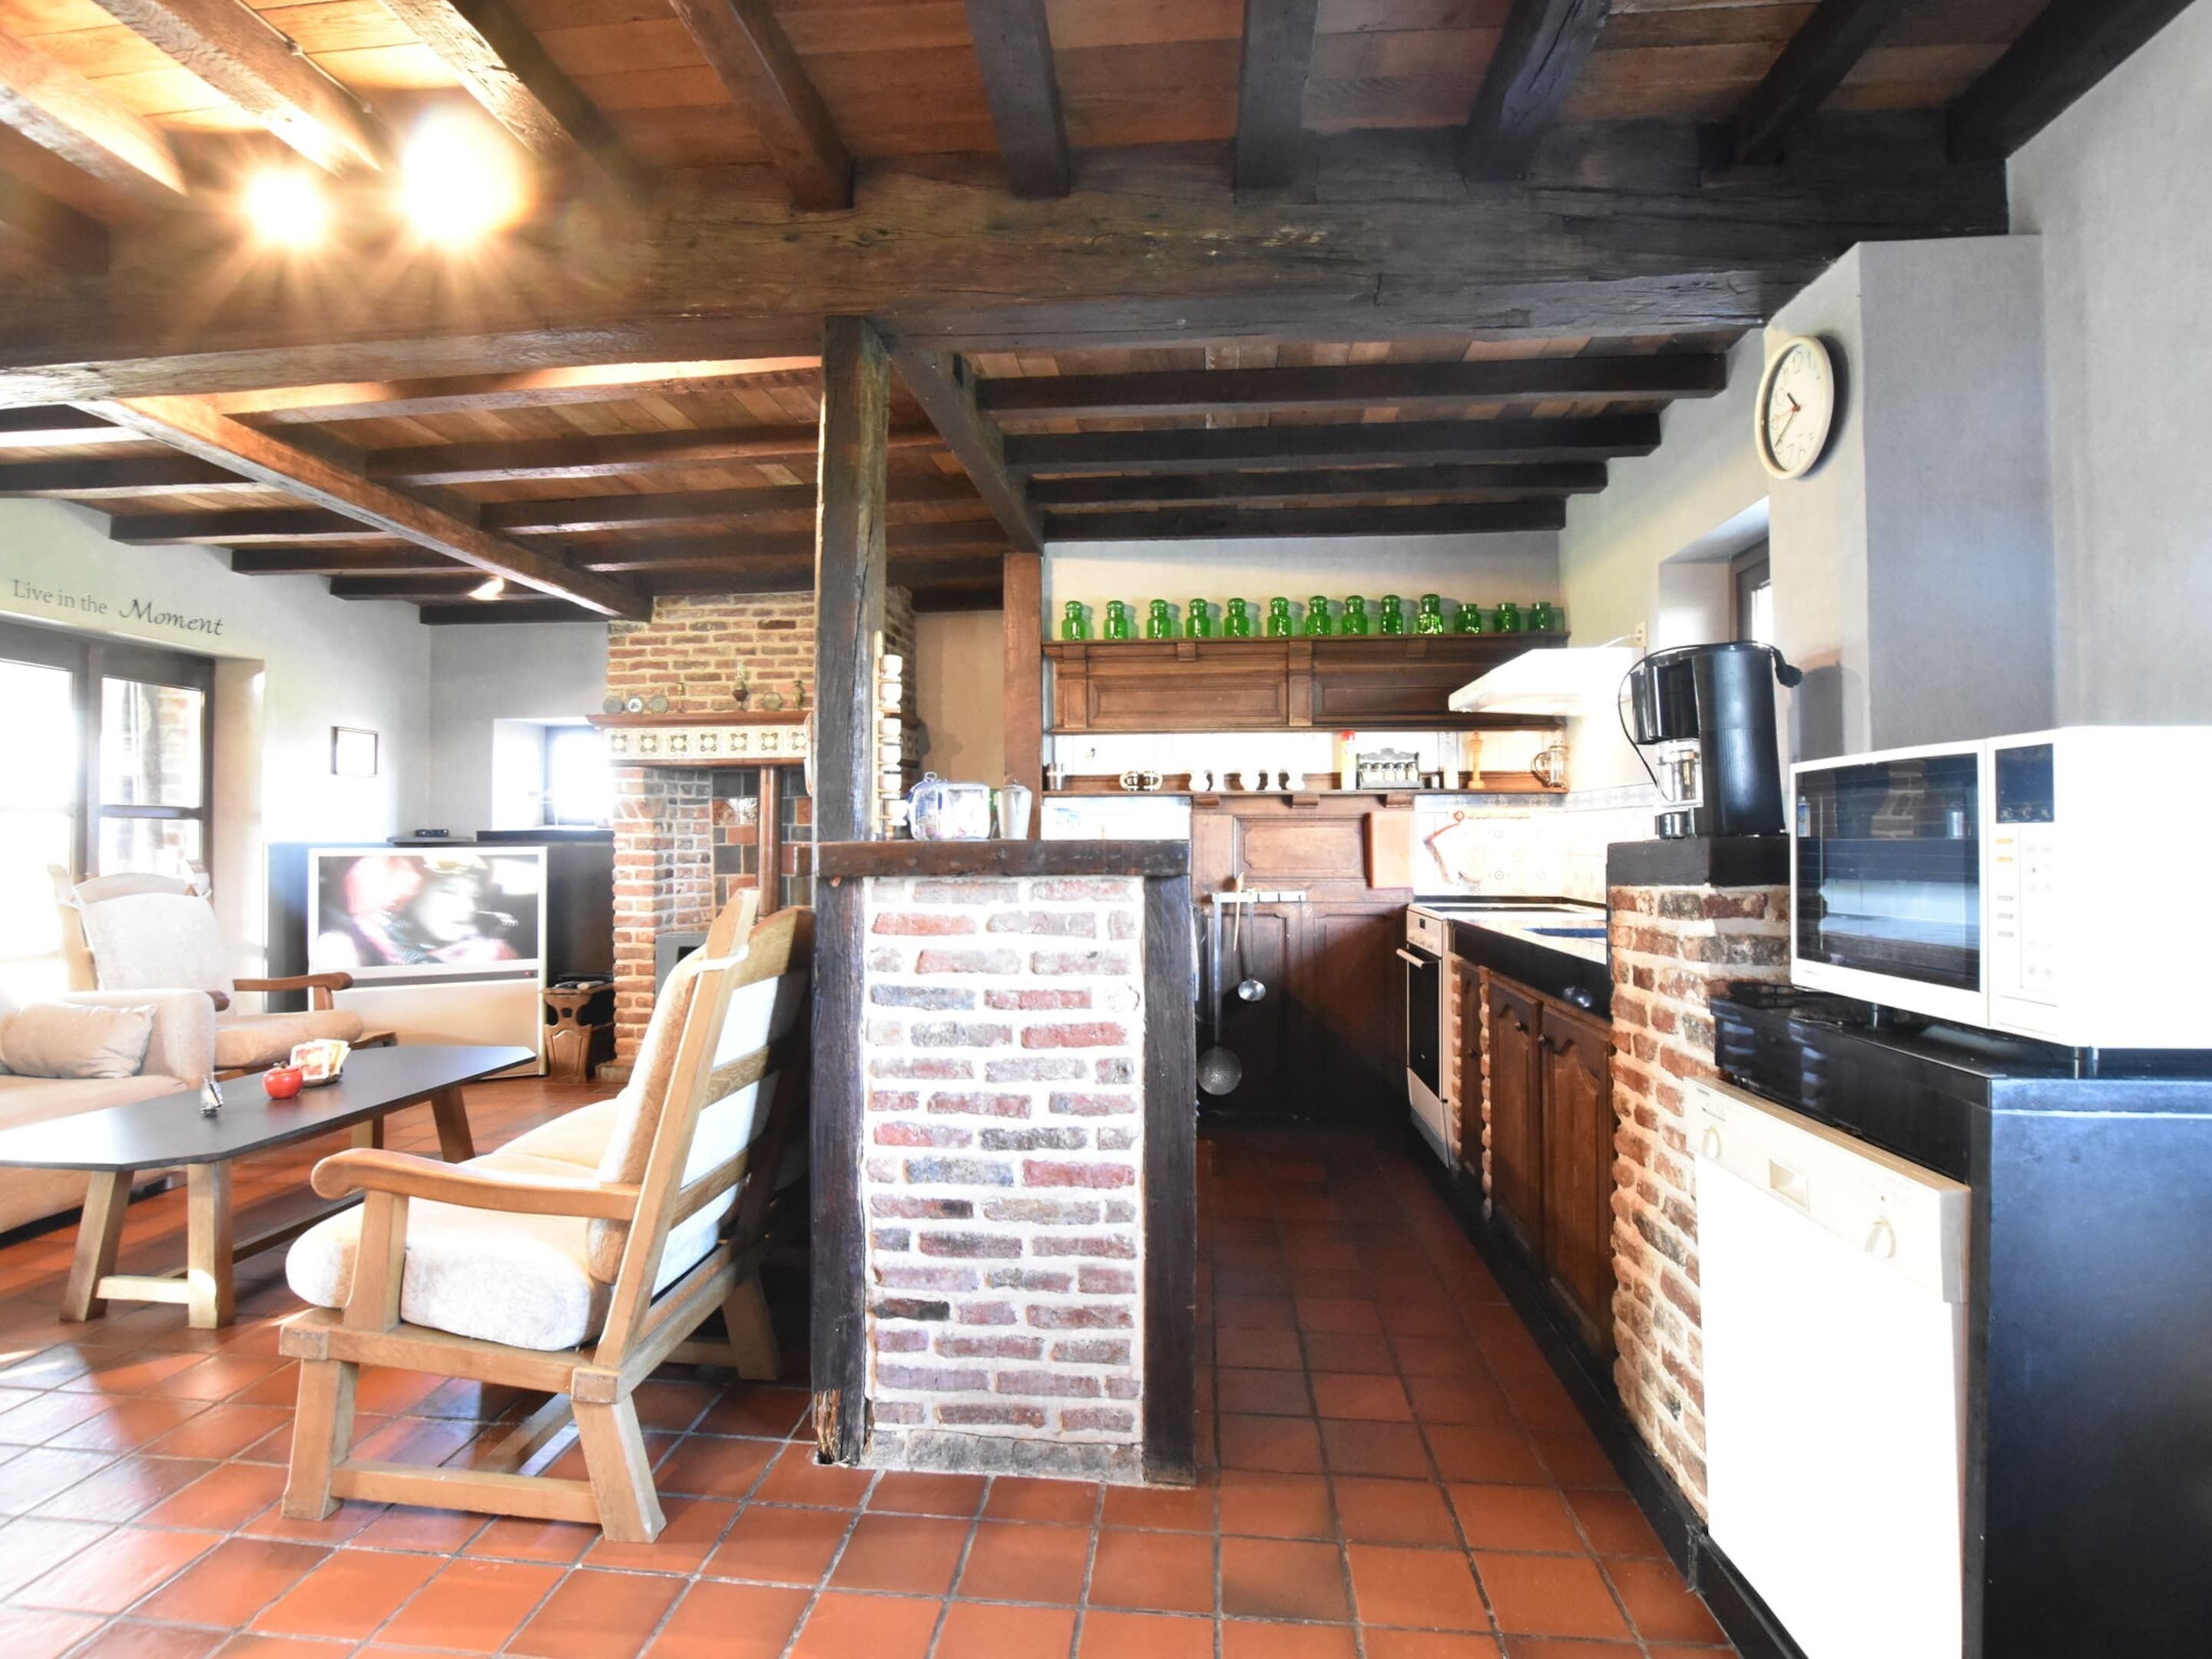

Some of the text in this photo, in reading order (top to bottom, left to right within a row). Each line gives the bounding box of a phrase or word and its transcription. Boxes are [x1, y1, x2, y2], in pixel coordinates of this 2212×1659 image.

[13, 579, 224, 636] Live in the Moment
